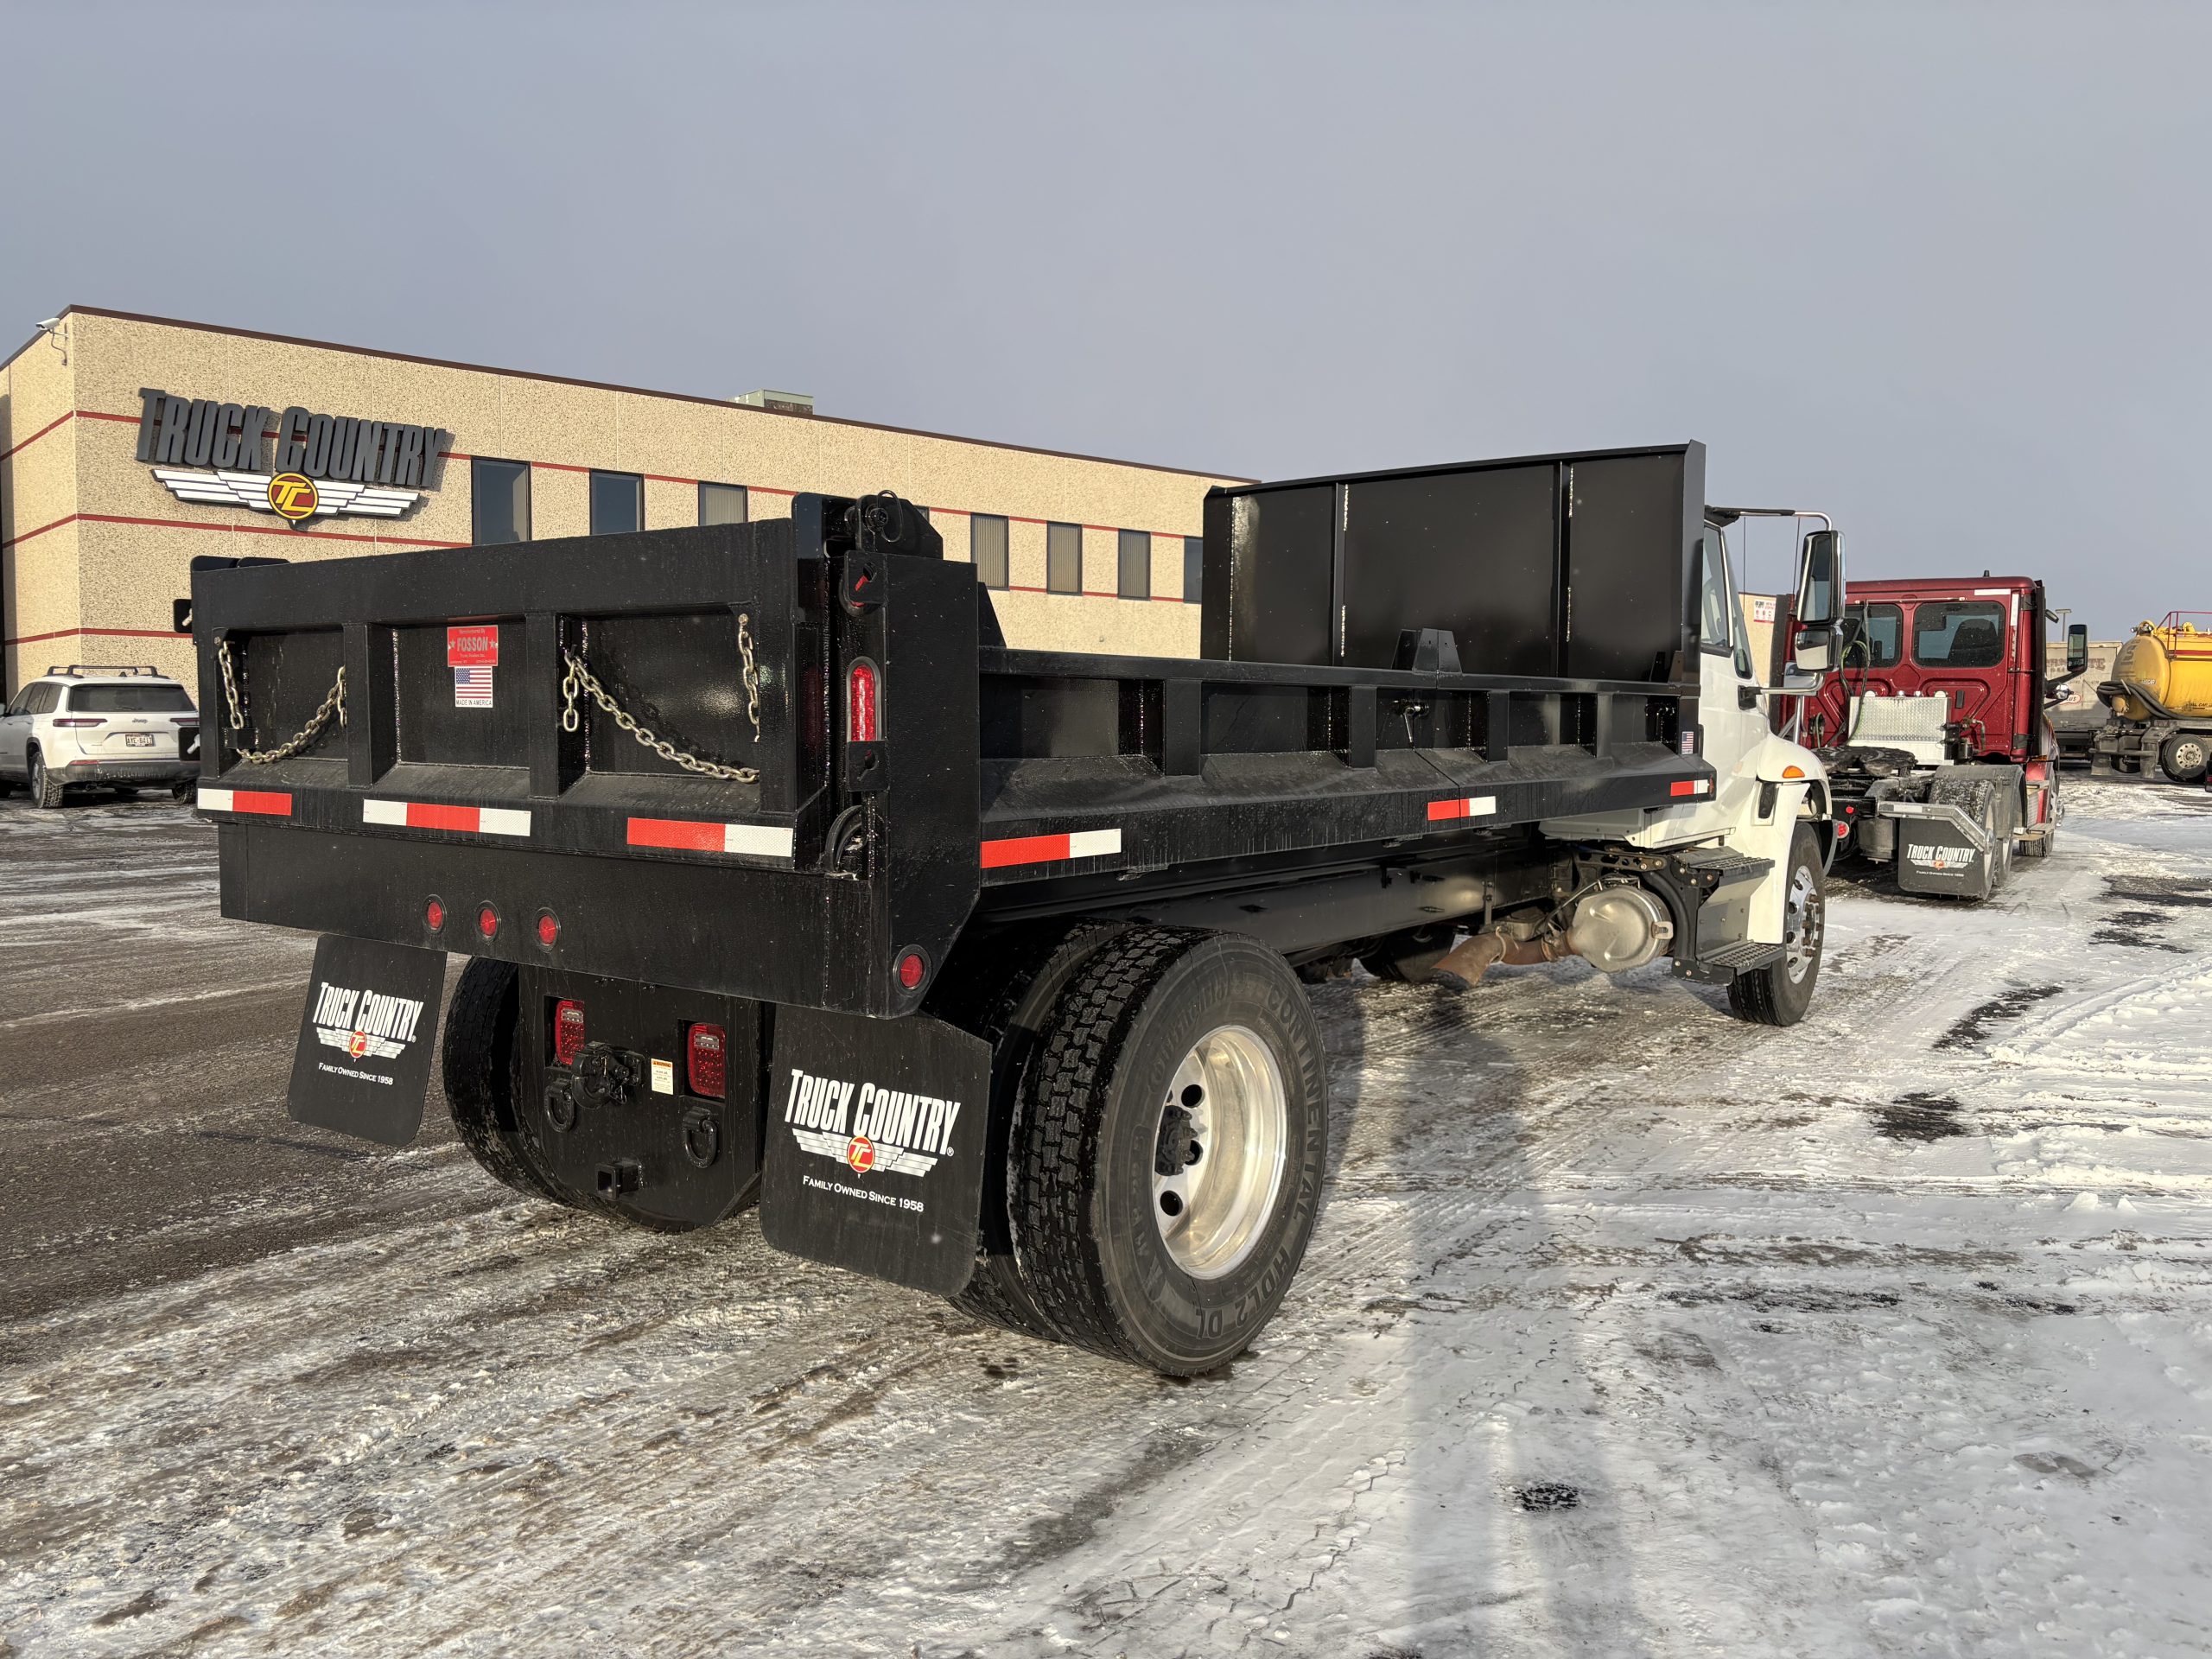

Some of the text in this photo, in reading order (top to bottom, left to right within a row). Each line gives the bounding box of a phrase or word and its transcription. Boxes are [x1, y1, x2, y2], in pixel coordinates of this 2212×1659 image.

[135, 387, 447, 487] TRUCK COUNTRY
[271, 480, 312, 512] TC
[456, 636, 488, 652] FOSSON
[1907, 843, 1976, 862] TRUCK COUNTRY
[312, 982, 424, 1042] TRUCK COUNTRY
[318, 1063, 394, 1086] FAMILY OWNED SINCE 1958
[785, 1068, 961, 1155] TRUCK COUNTRY
[803, 1175, 925, 1212] FAMILY OWNED SINCE 1958
[1235, 1245, 1291, 1328] HDL2
